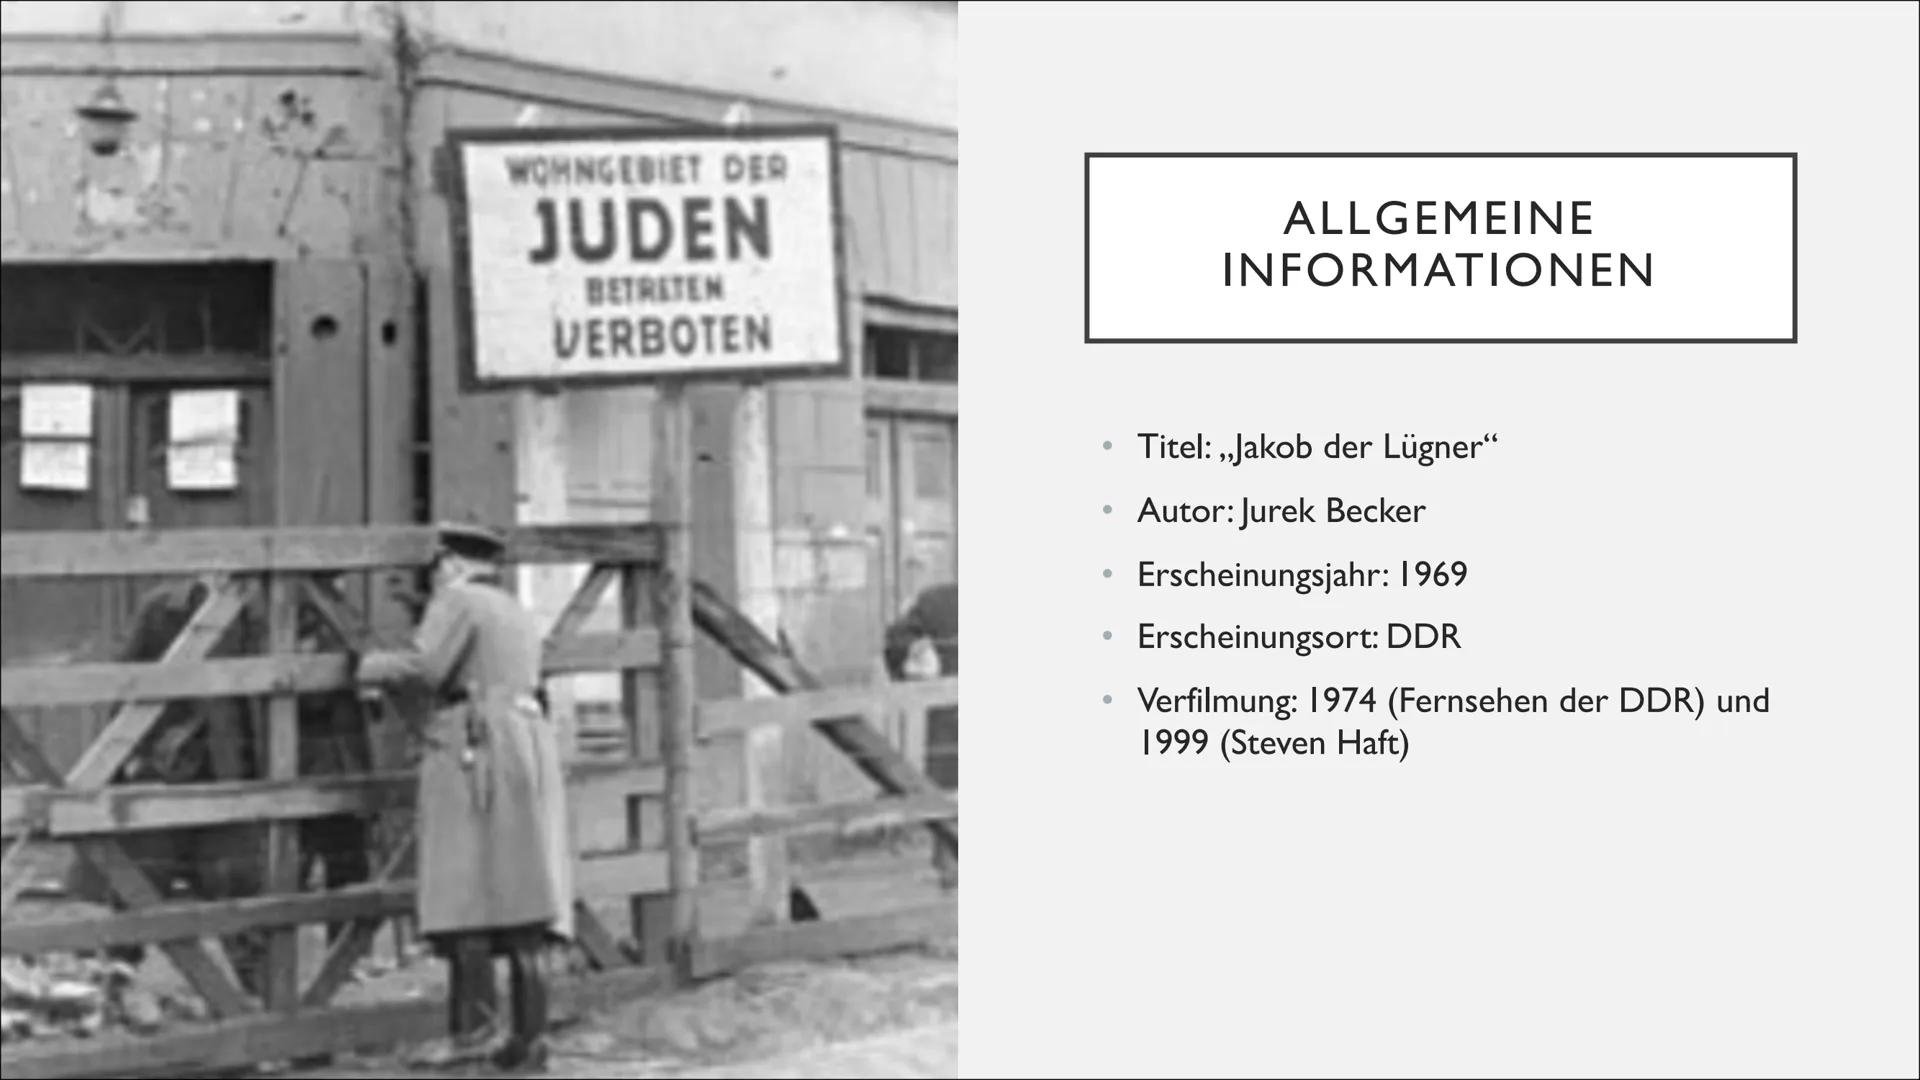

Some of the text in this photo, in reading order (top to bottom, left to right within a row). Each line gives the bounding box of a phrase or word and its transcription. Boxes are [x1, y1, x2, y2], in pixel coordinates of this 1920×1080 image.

[505, 152, 788, 186] WOHNGEBIET DER
[529, 196, 771, 264] JUDEN
[585, 273, 723, 307] BETRETEN
[554, 314, 773, 359] VERBOTEN
